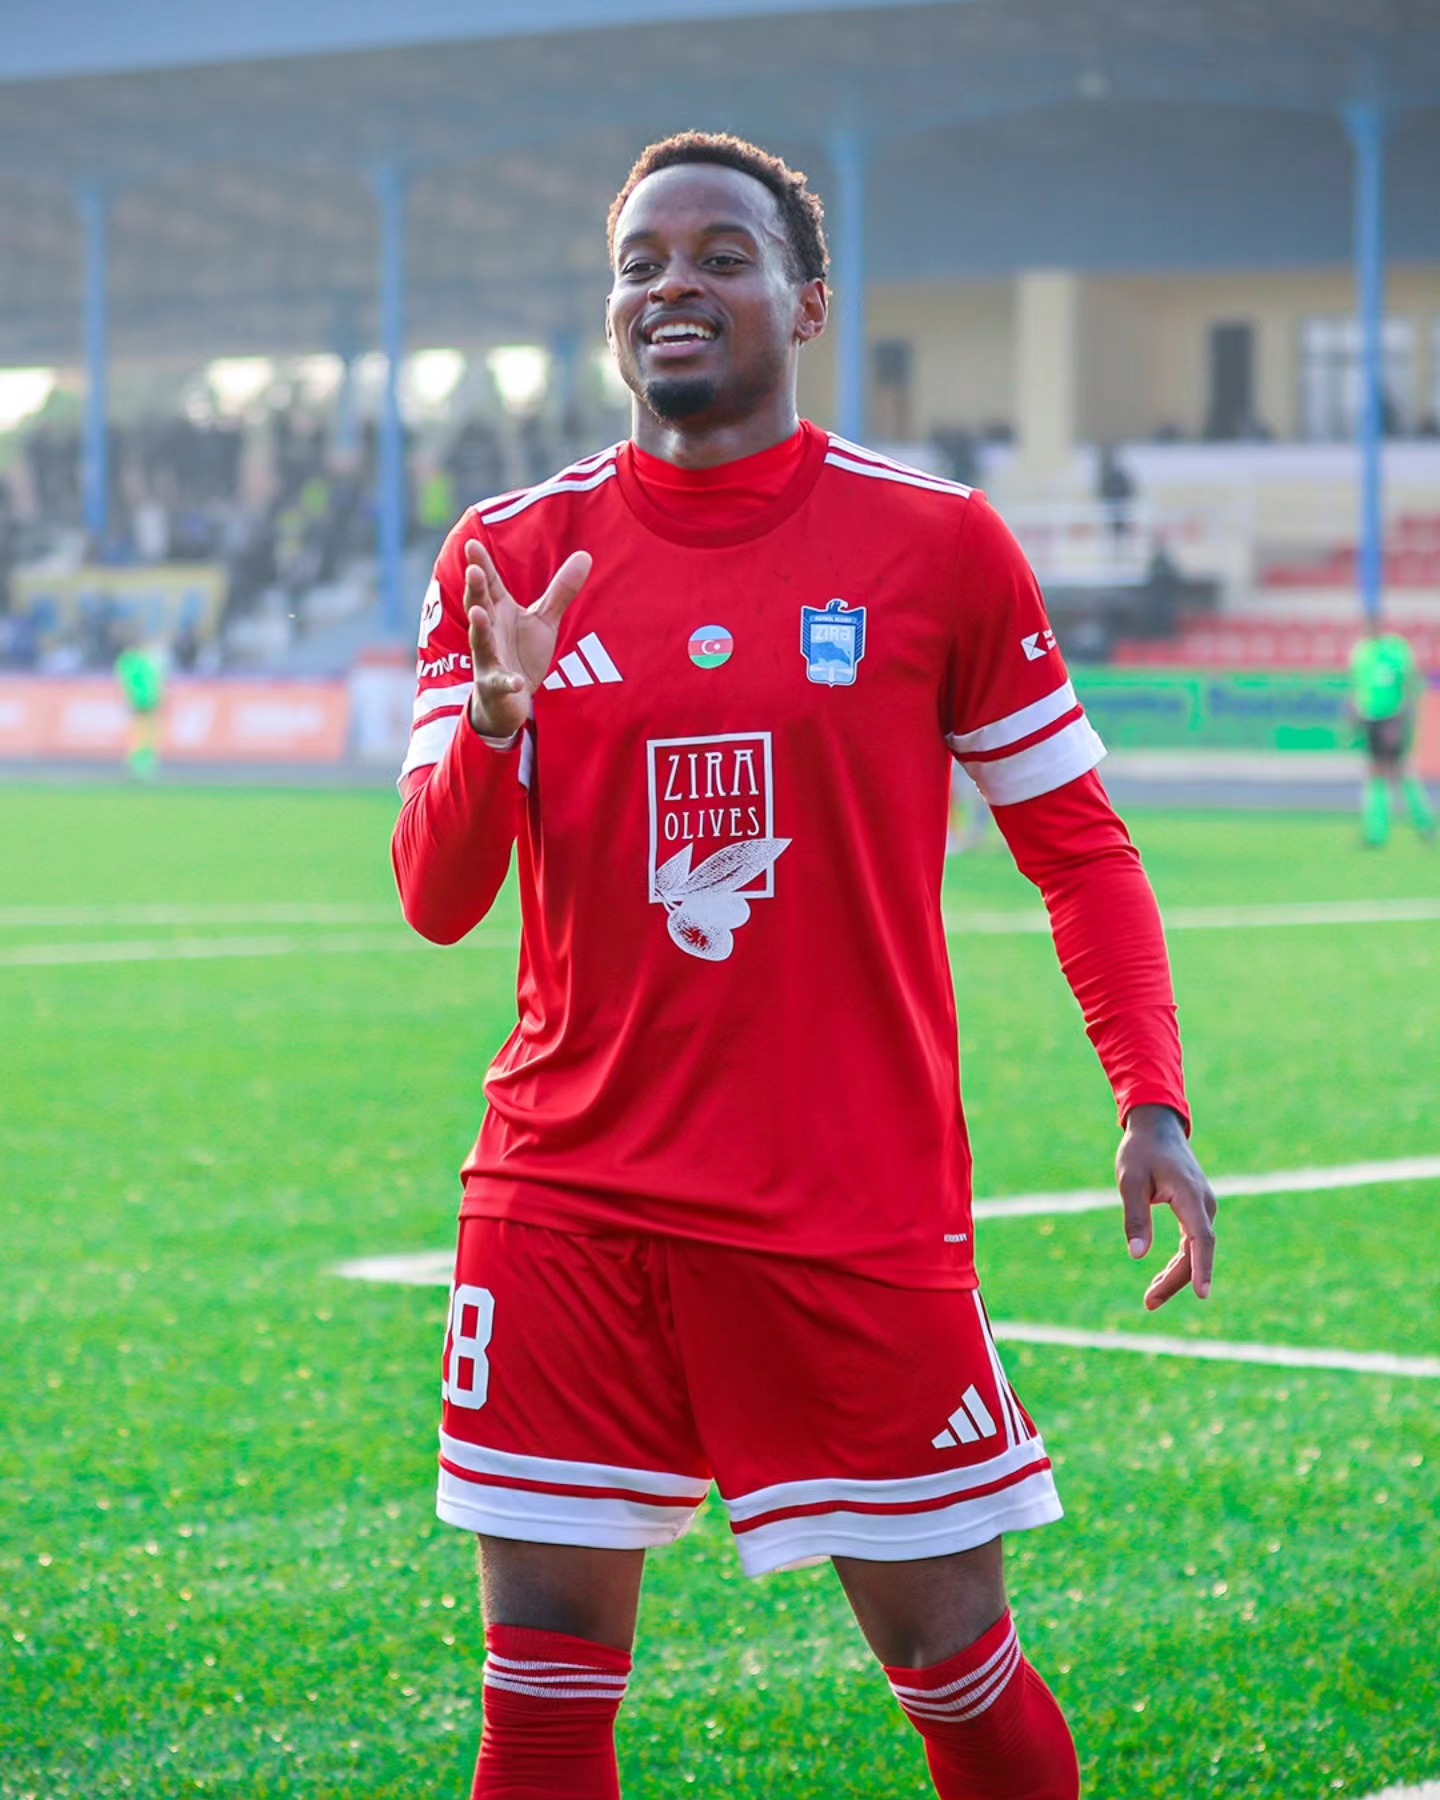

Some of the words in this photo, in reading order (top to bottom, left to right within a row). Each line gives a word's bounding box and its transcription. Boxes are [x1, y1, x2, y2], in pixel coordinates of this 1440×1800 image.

[664, 749, 760, 801] ZIRA
[664, 806, 760, 840] OLIVES
[441, 1283, 496, 1410] 8
